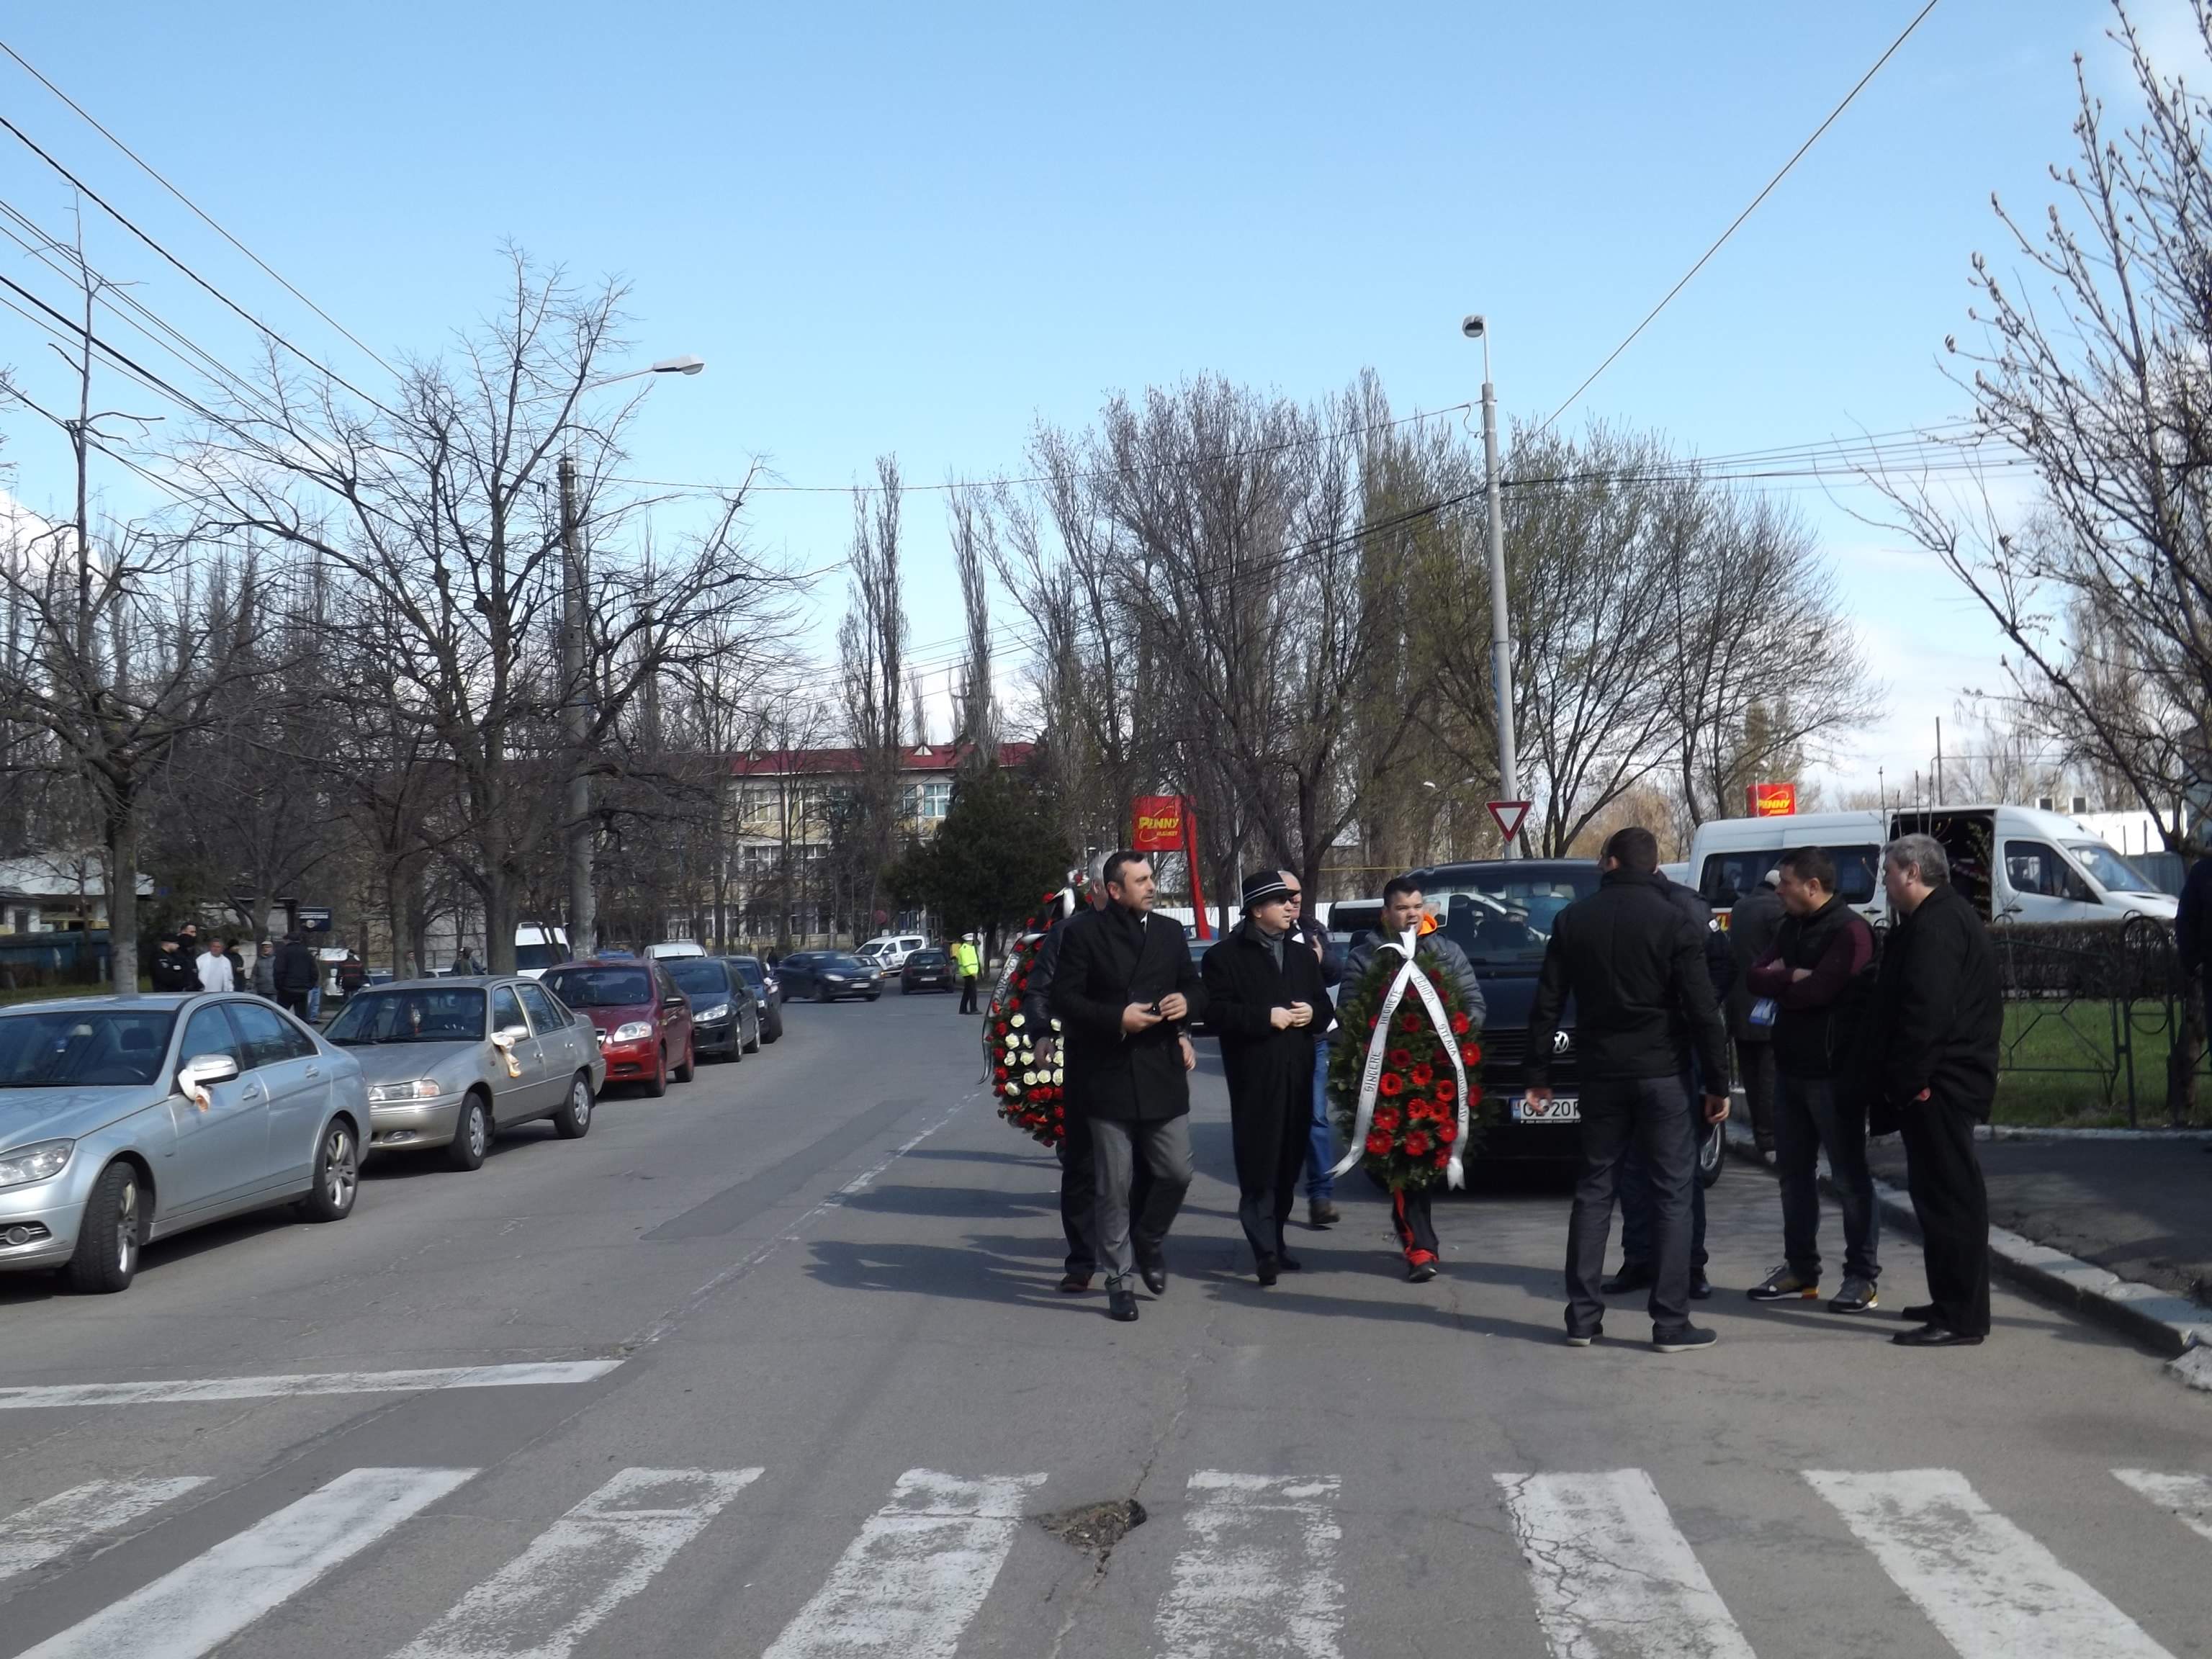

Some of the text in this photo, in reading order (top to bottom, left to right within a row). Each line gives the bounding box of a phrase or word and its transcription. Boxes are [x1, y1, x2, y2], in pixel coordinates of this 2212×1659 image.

[1138, 816, 1179, 830] PENNY
[1364, 1051, 1382, 1092] SINCERE
[1552, 1101, 1570, 1117] 20
